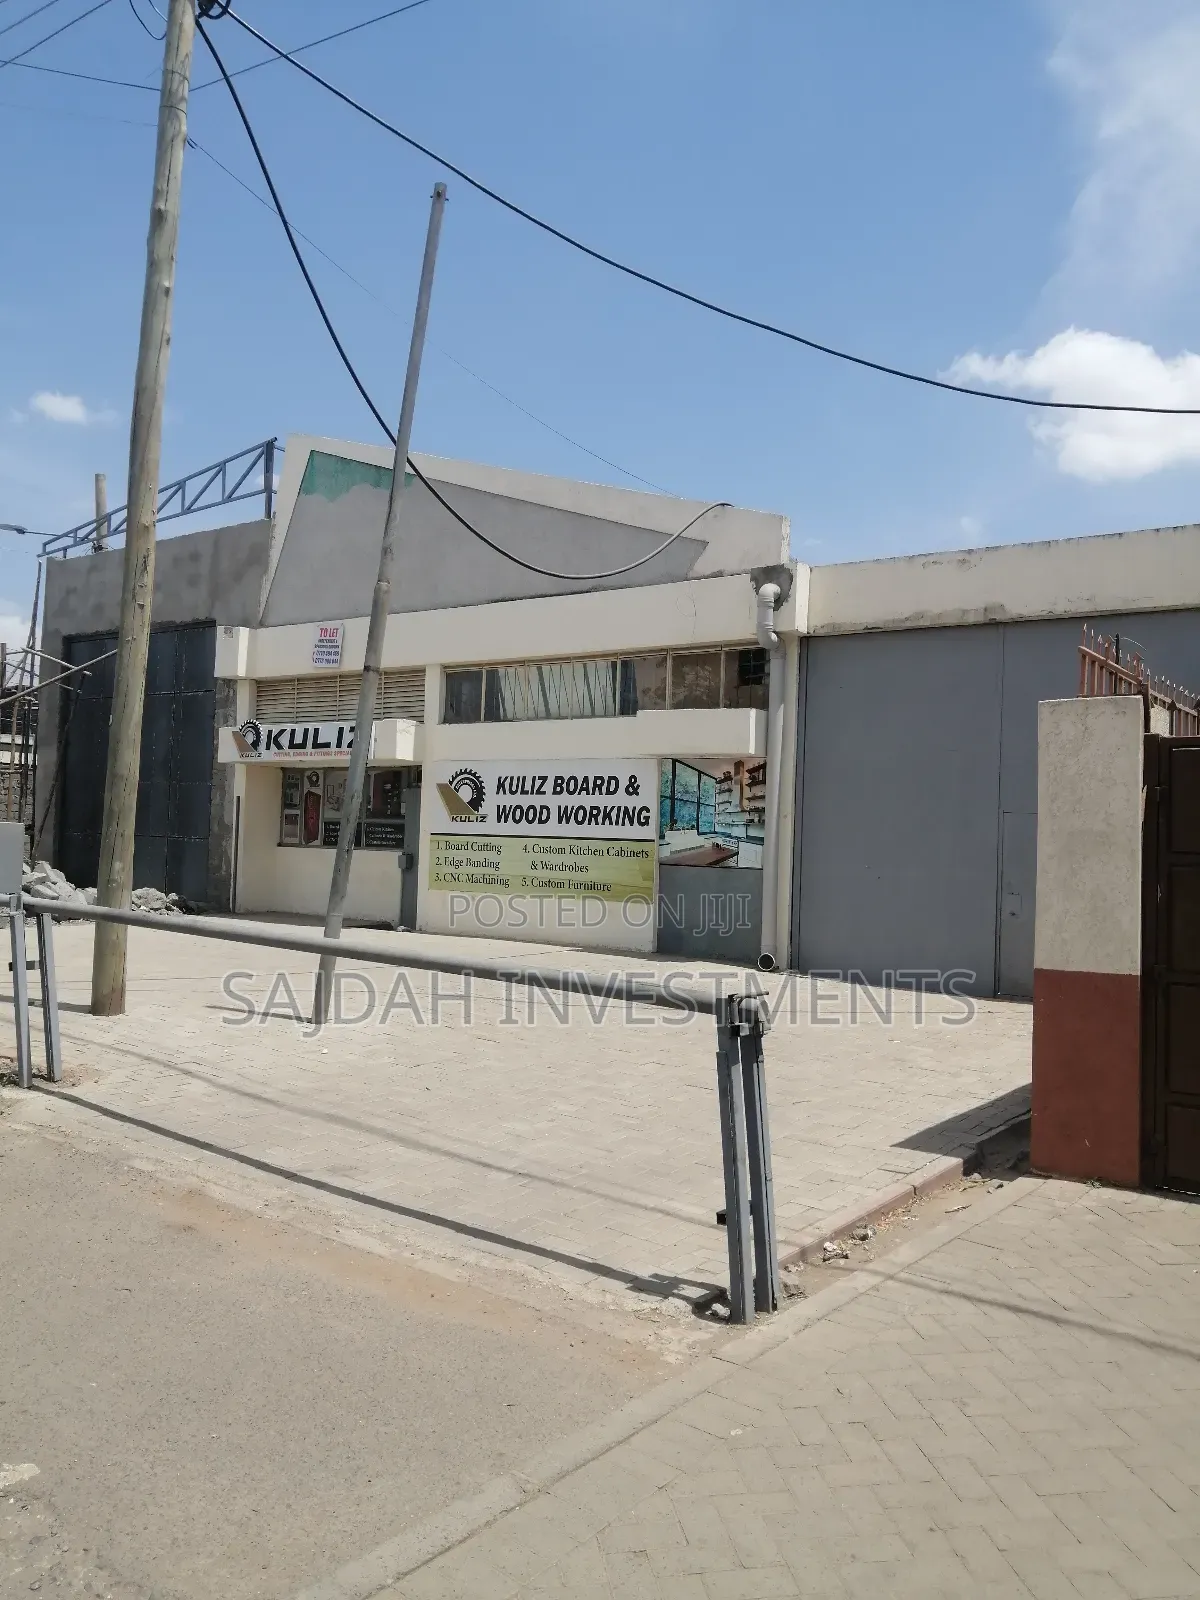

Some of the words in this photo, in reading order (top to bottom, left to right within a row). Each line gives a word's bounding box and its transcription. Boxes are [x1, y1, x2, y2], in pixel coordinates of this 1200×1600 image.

[319, 628, 329, 638] TO
[329, 628, 339, 638] LET
[496, 776, 548, 795] KULIZ
[552, 776, 620, 796] BOARD
[625, 775, 640, 796] &
[451, 815, 488, 823] KULIZ
[496, 805, 550, 824] WOOD
[557, 805, 650, 826] WORKING
[436, 841, 443, 850] 1.
[445, 841, 469, 850] Board
[471, 842, 502, 855] Cutting
[522, 844, 530, 853] 4.
[532, 844, 566, 855] Custom
[568, 844, 604, 856] Kitchen
[606, 846, 649, 858] Cabinets
[435, 857, 442, 866] 2.
[444, 857, 463, 869] Edge
[465, 858, 500, 871] Banding
[530, 860, 538, 870] &
[540, 860, 589, 873] Wardrobes
[434, 873, 442, 882] 3.
[443, 873, 464, 882] CNC
[465, 873, 510, 888] Machining
[521, 877, 528, 887] 5.
[531, 877, 565, 889] Custom
[568, 879, 612, 891] Furniture
